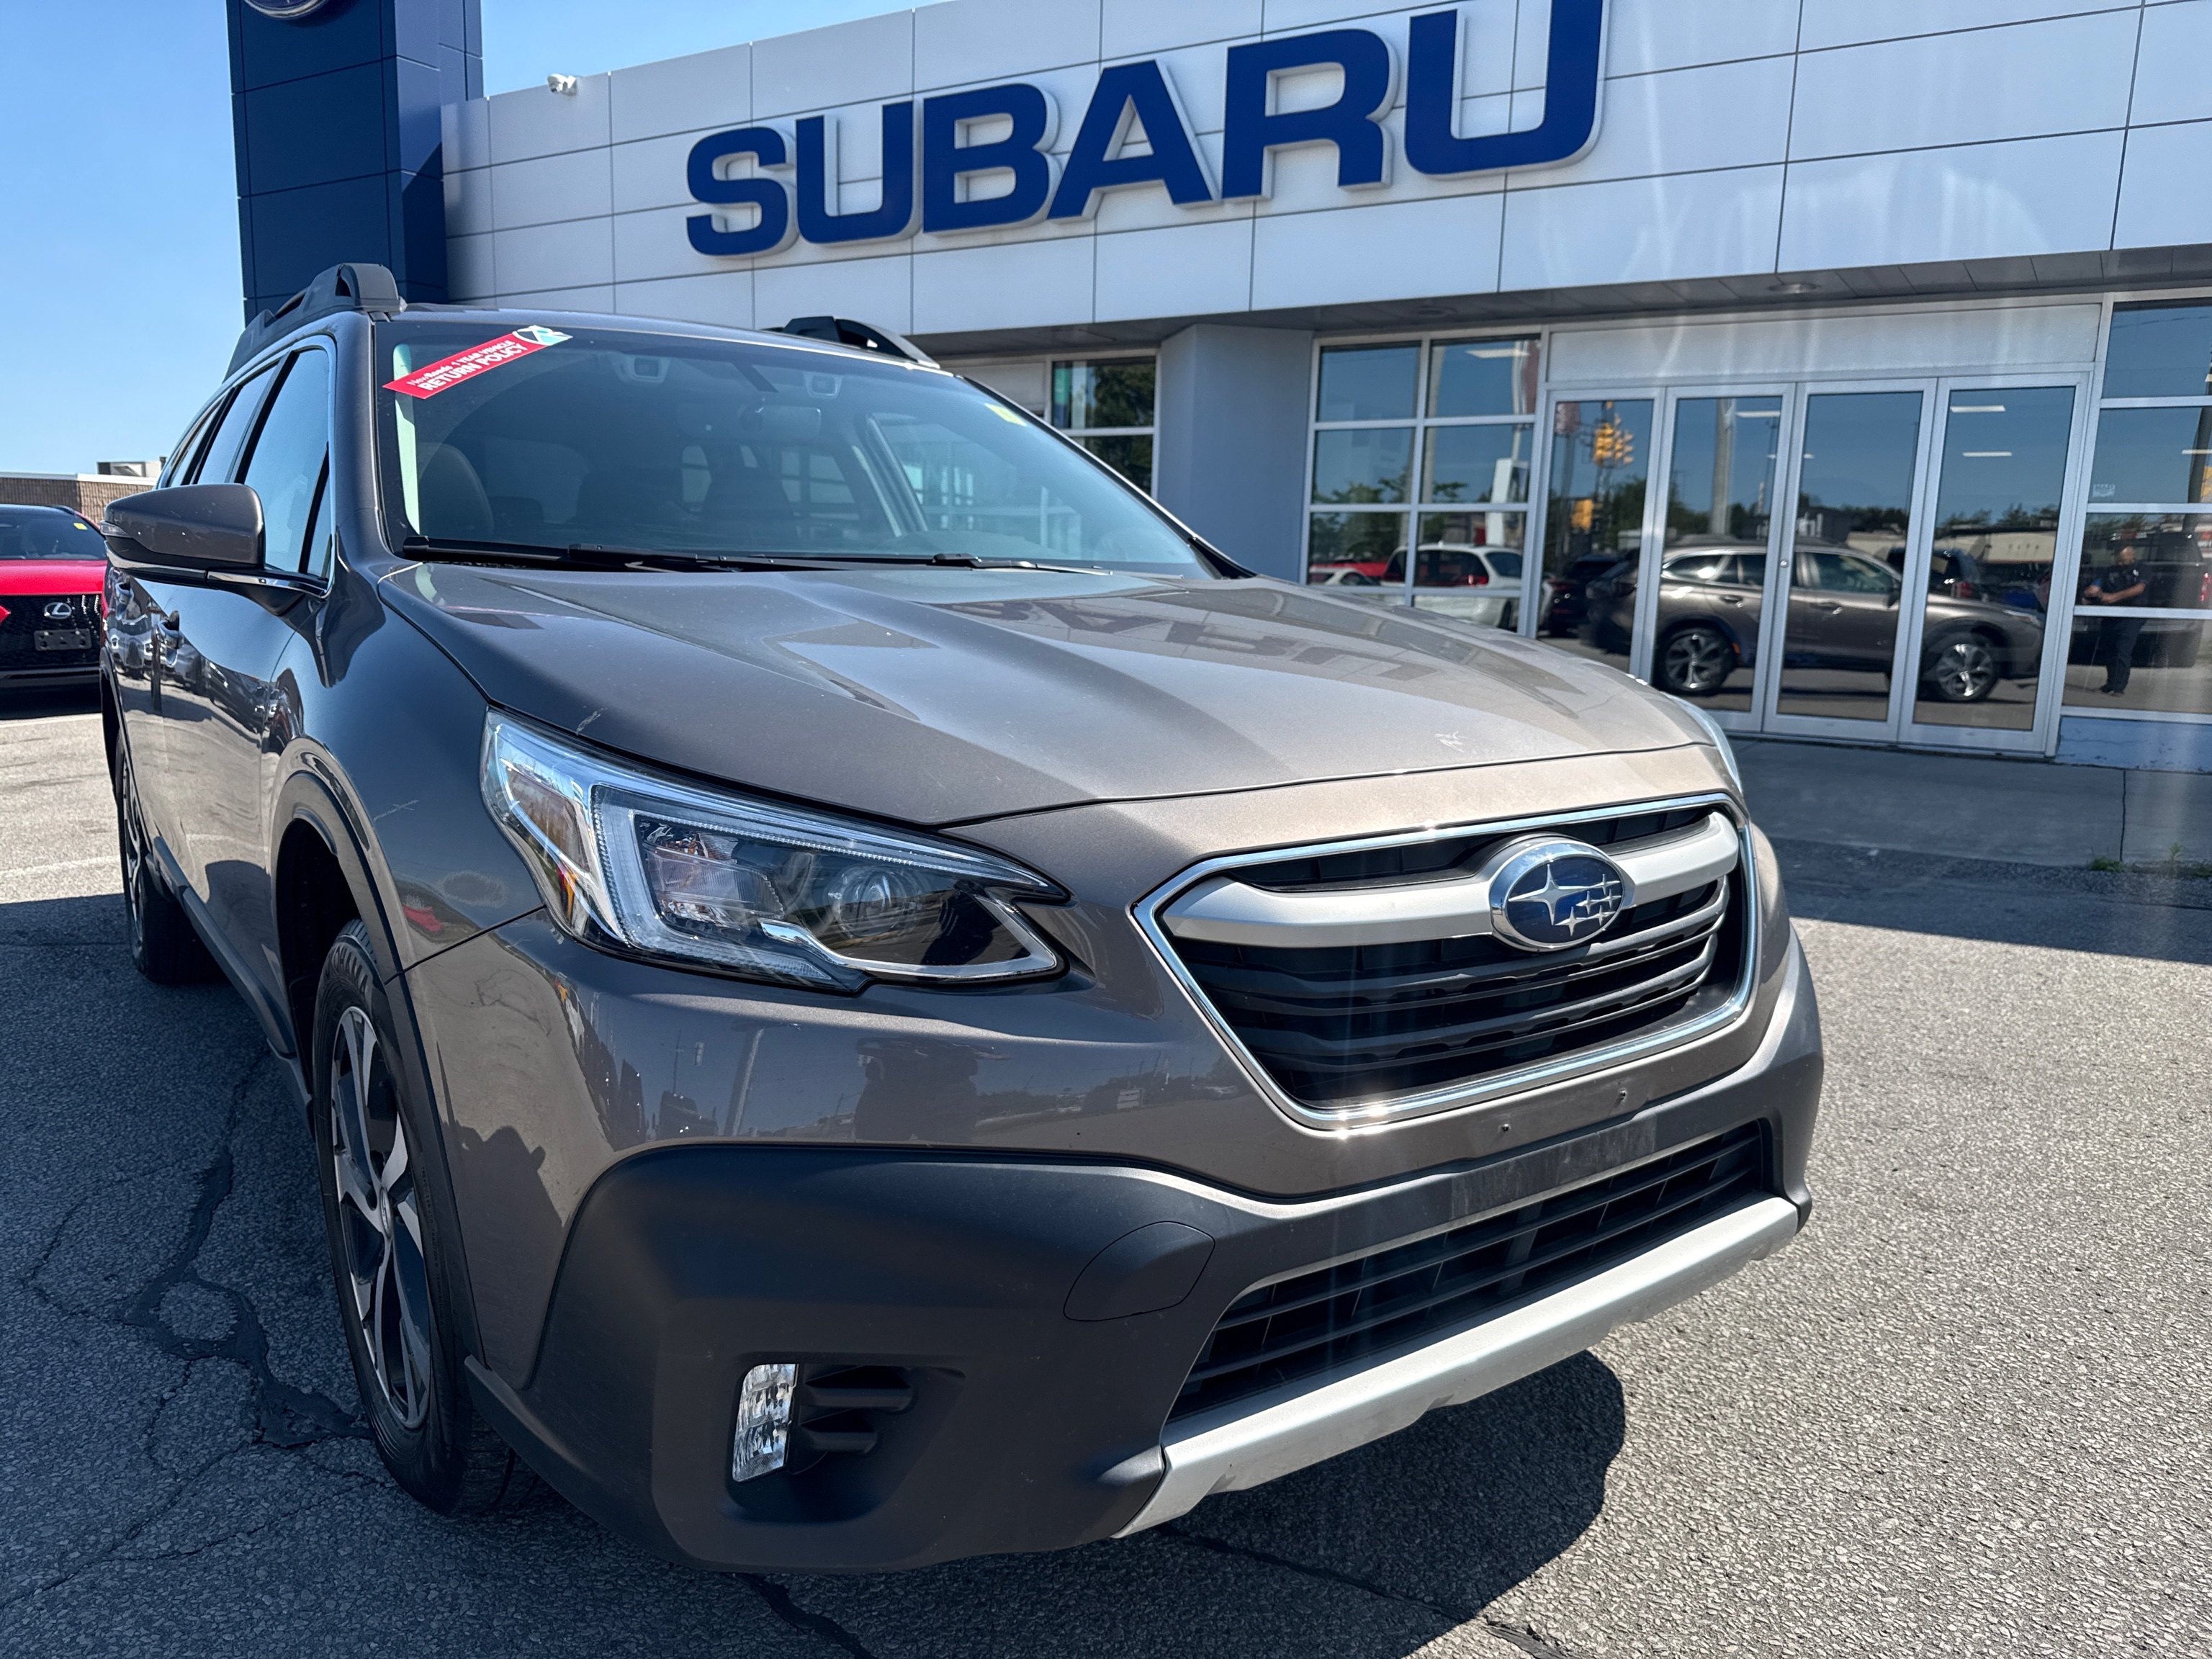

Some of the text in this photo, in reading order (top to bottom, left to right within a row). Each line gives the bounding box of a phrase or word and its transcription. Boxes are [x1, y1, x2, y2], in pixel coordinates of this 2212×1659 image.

[686, 0, 1606, 257] SUBARU
[418, 343, 528, 390] RETURN POLICY
[456, 352, 483, 363] YEAR
[478, 340, 516, 355] VEHICLE
